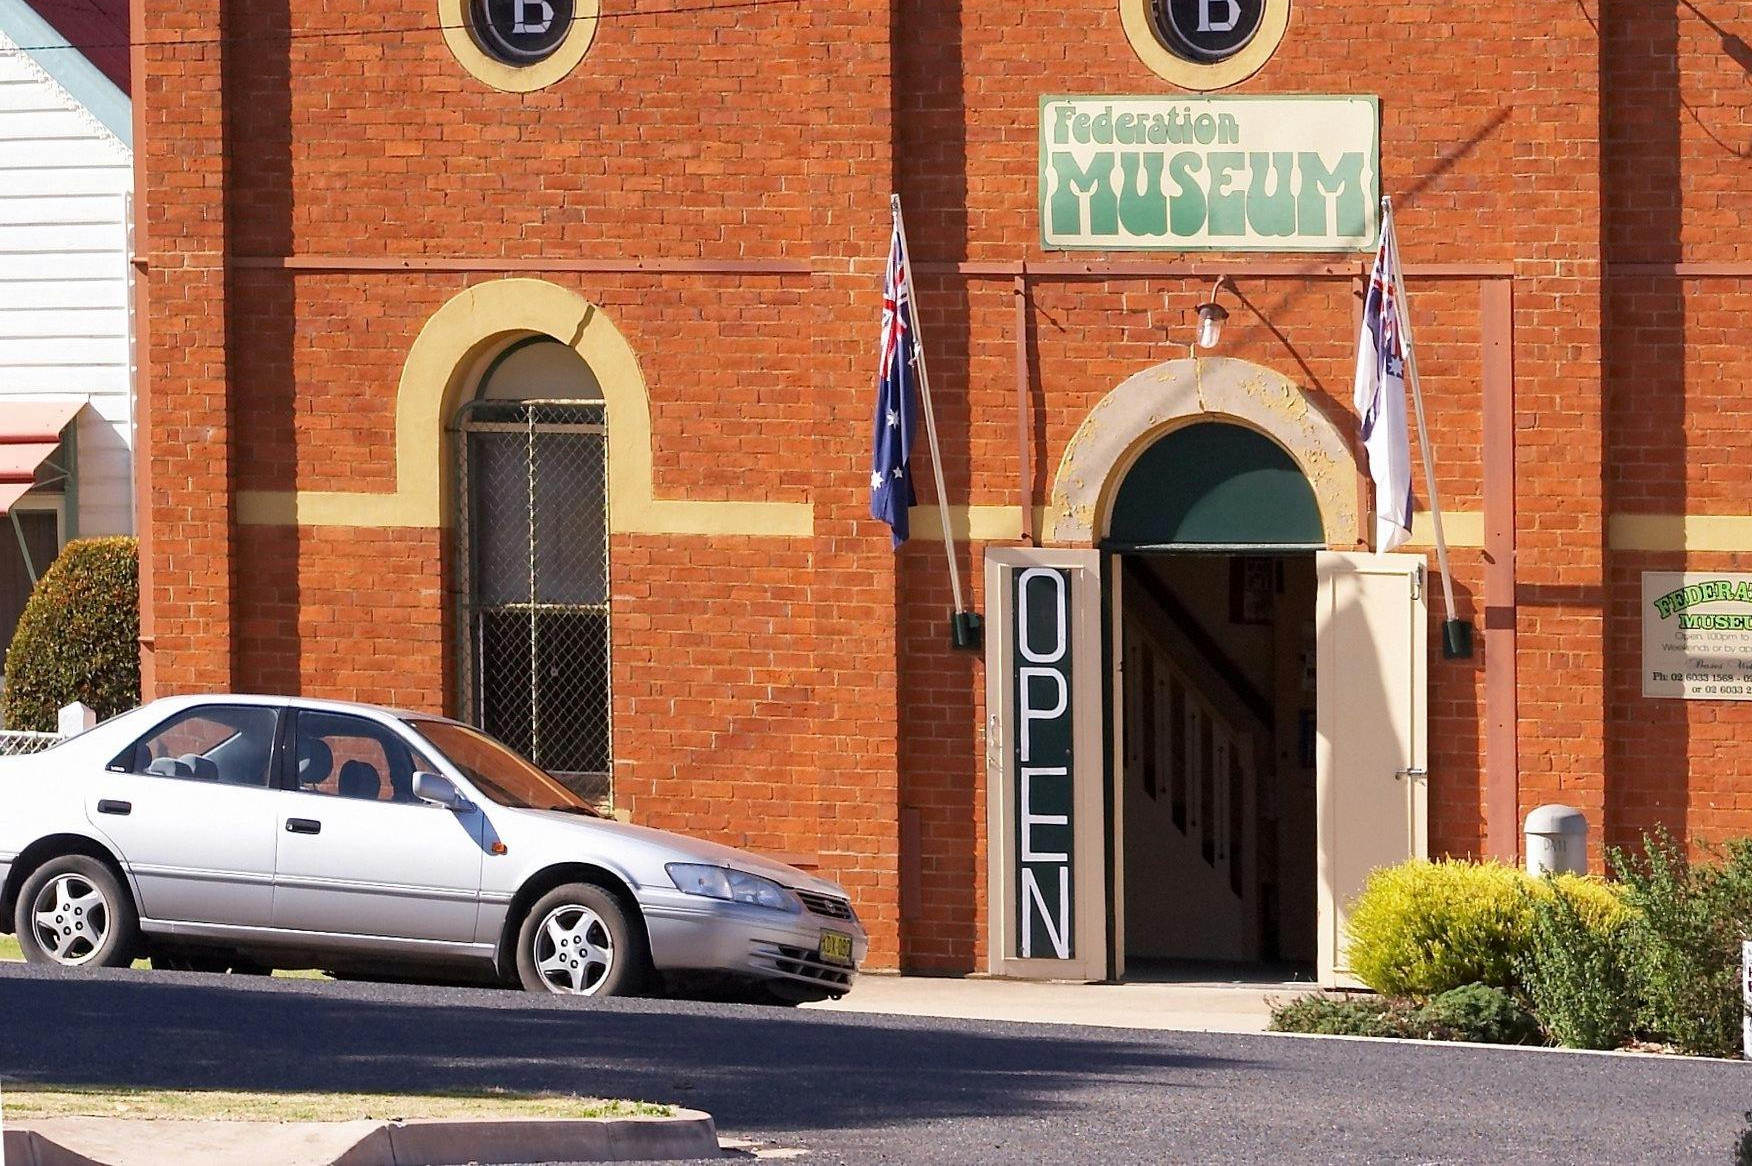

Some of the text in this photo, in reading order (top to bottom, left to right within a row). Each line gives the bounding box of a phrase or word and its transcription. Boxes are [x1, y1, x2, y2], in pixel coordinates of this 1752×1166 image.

[1053, 106, 1240, 145] Federation
[1051, 151, 1367, 238] MUSEUM
[1674, 631, 1703, 642] Open
[1740, 633, 1750, 642] to
[1661, 643, 1710, 652] Weekends
[1712, 645, 1722, 653] or
[1724, 644, 1736, 654] by
[1671, 672, 1683, 682] 02
[1685, 673, 1709, 682] 6033
[1704, 685, 1717, 694] 02
[1719, 685, 1743, 694] 6033
[1018, 567, 1070, 960] OPEN
